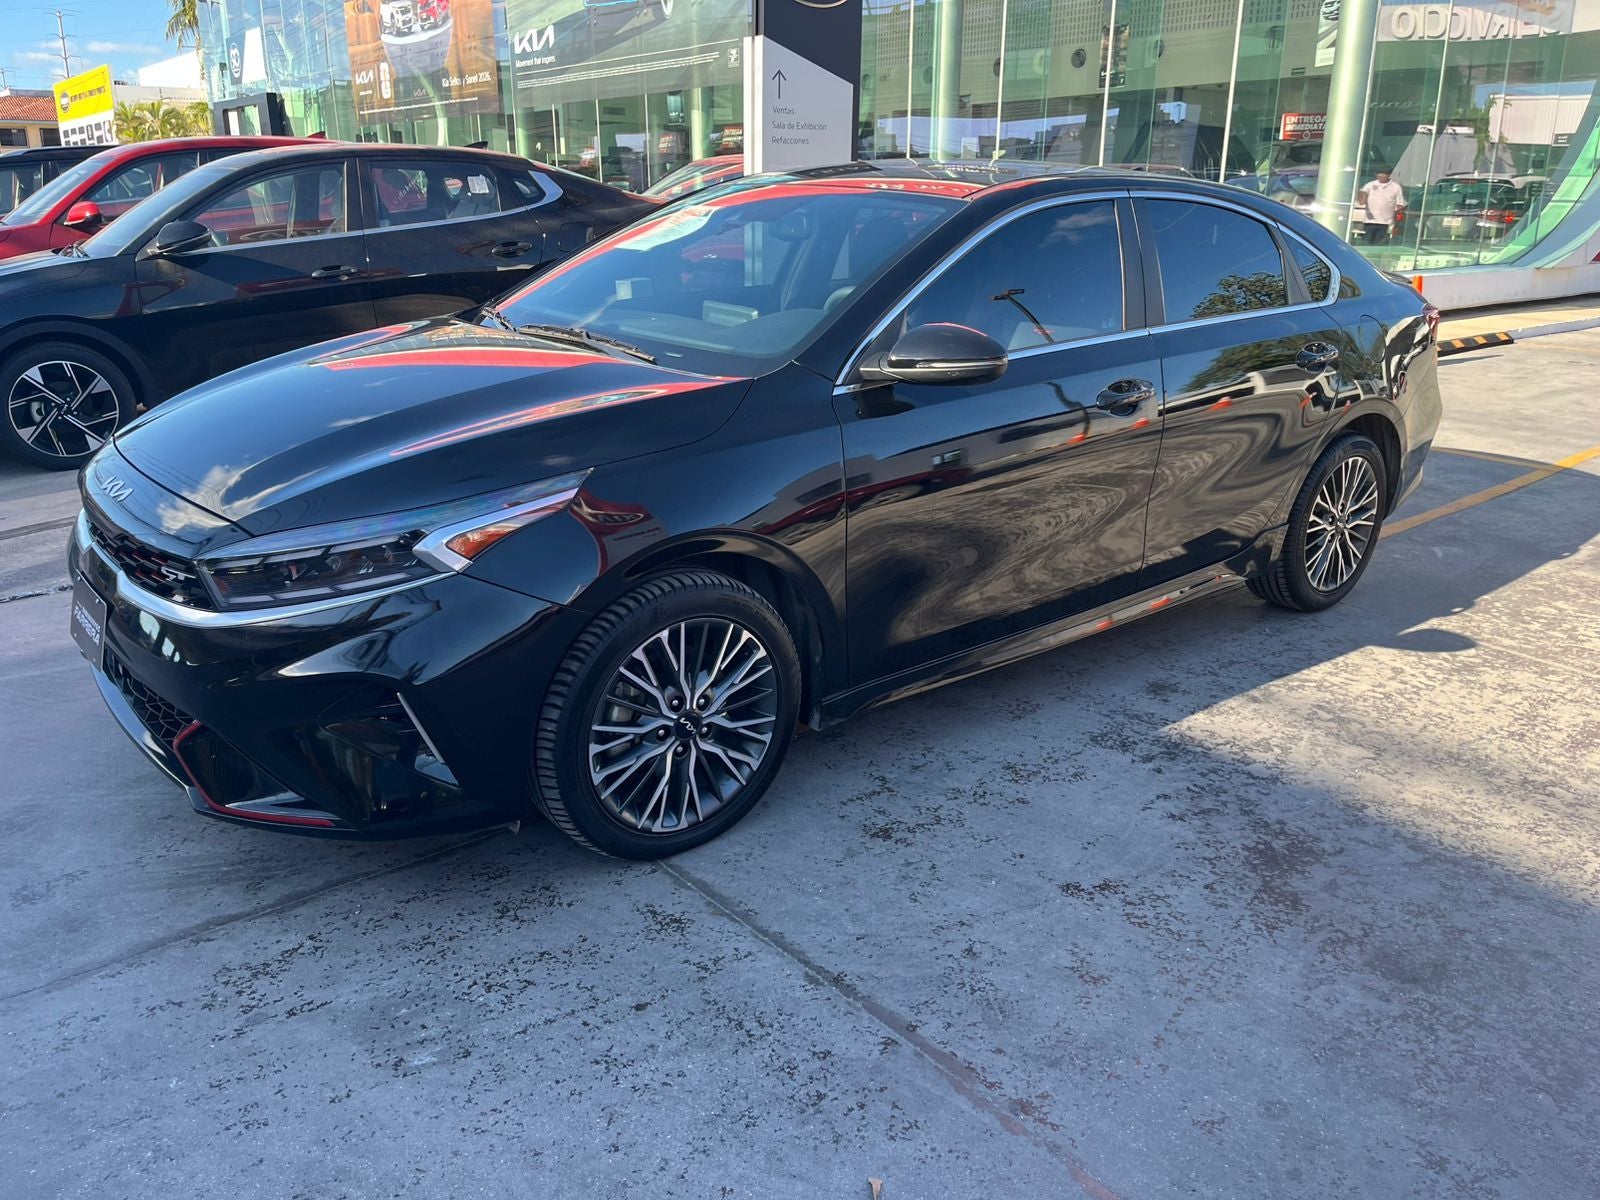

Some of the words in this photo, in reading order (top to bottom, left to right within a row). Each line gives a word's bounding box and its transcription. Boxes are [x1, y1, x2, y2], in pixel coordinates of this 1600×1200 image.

[513, 25, 555, 54] KIA
[355, 69, 374, 85] KIA
[772, 105, 795, 115] Ventas
[771, 120, 786, 130] Sala
[787, 121, 795, 130] de
[796, 121, 827, 131] Exhibición
[771, 135, 810, 145] Refacciones
[101, 475, 135, 502] KIA
